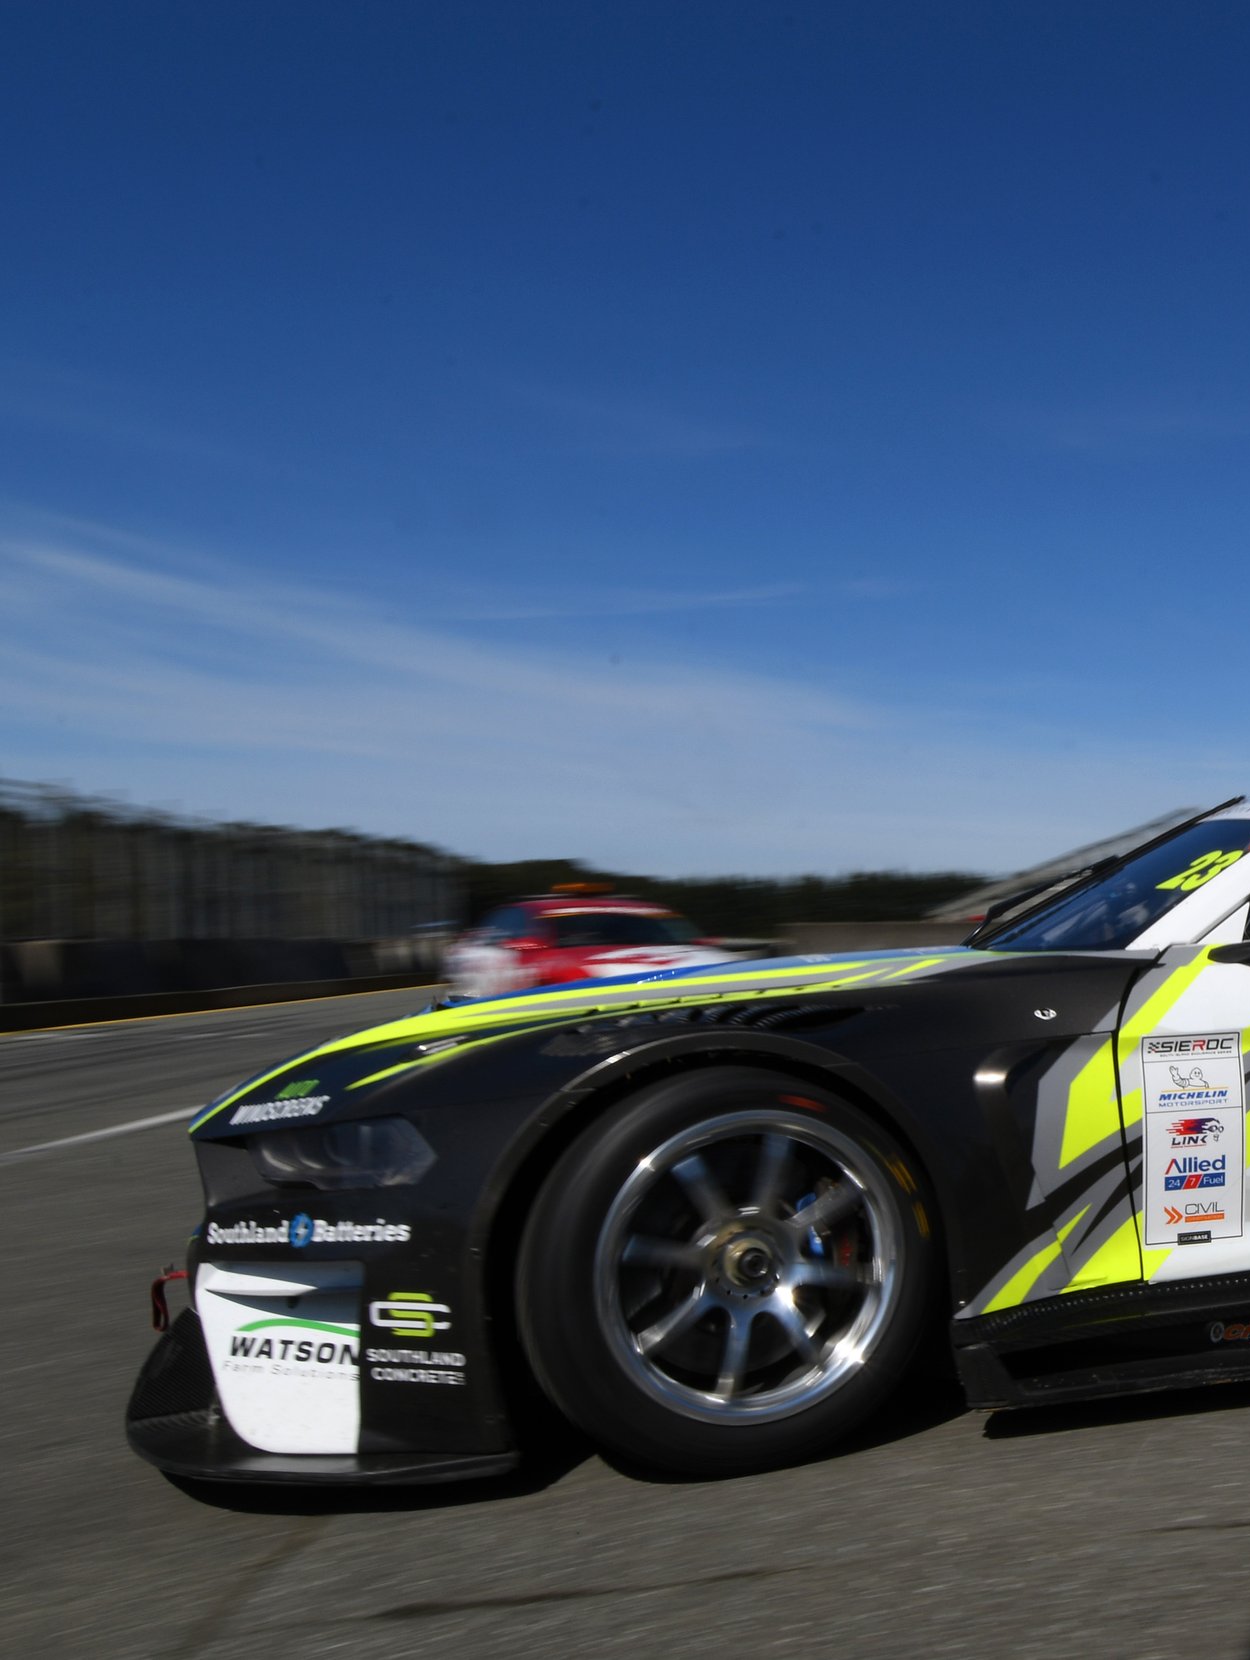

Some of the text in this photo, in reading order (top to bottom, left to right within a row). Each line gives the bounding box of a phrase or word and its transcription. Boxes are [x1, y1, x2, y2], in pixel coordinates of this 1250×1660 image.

[1155, 850, 1244, 892] 23
[1159, 1090, 1228, 1101] MICHELIN
[1158, 1099, 1228, 1108] MOTORSPORT
[1171, 1135, 1208, 1146] LINK
[1164, 1154, 1226, 1176] Allied
[1203, 1175, 1224, 1185] Fuel
[1184, 1201, 1225, 1216] CIVIL
[207, 1218, 411, 1244] Southland Batteries
[230, 1335, 360, 1367] WATSON
[366, 1348, 467, 1367] SOUTHLAND
[222, 1360, 264, 1374] Farm
